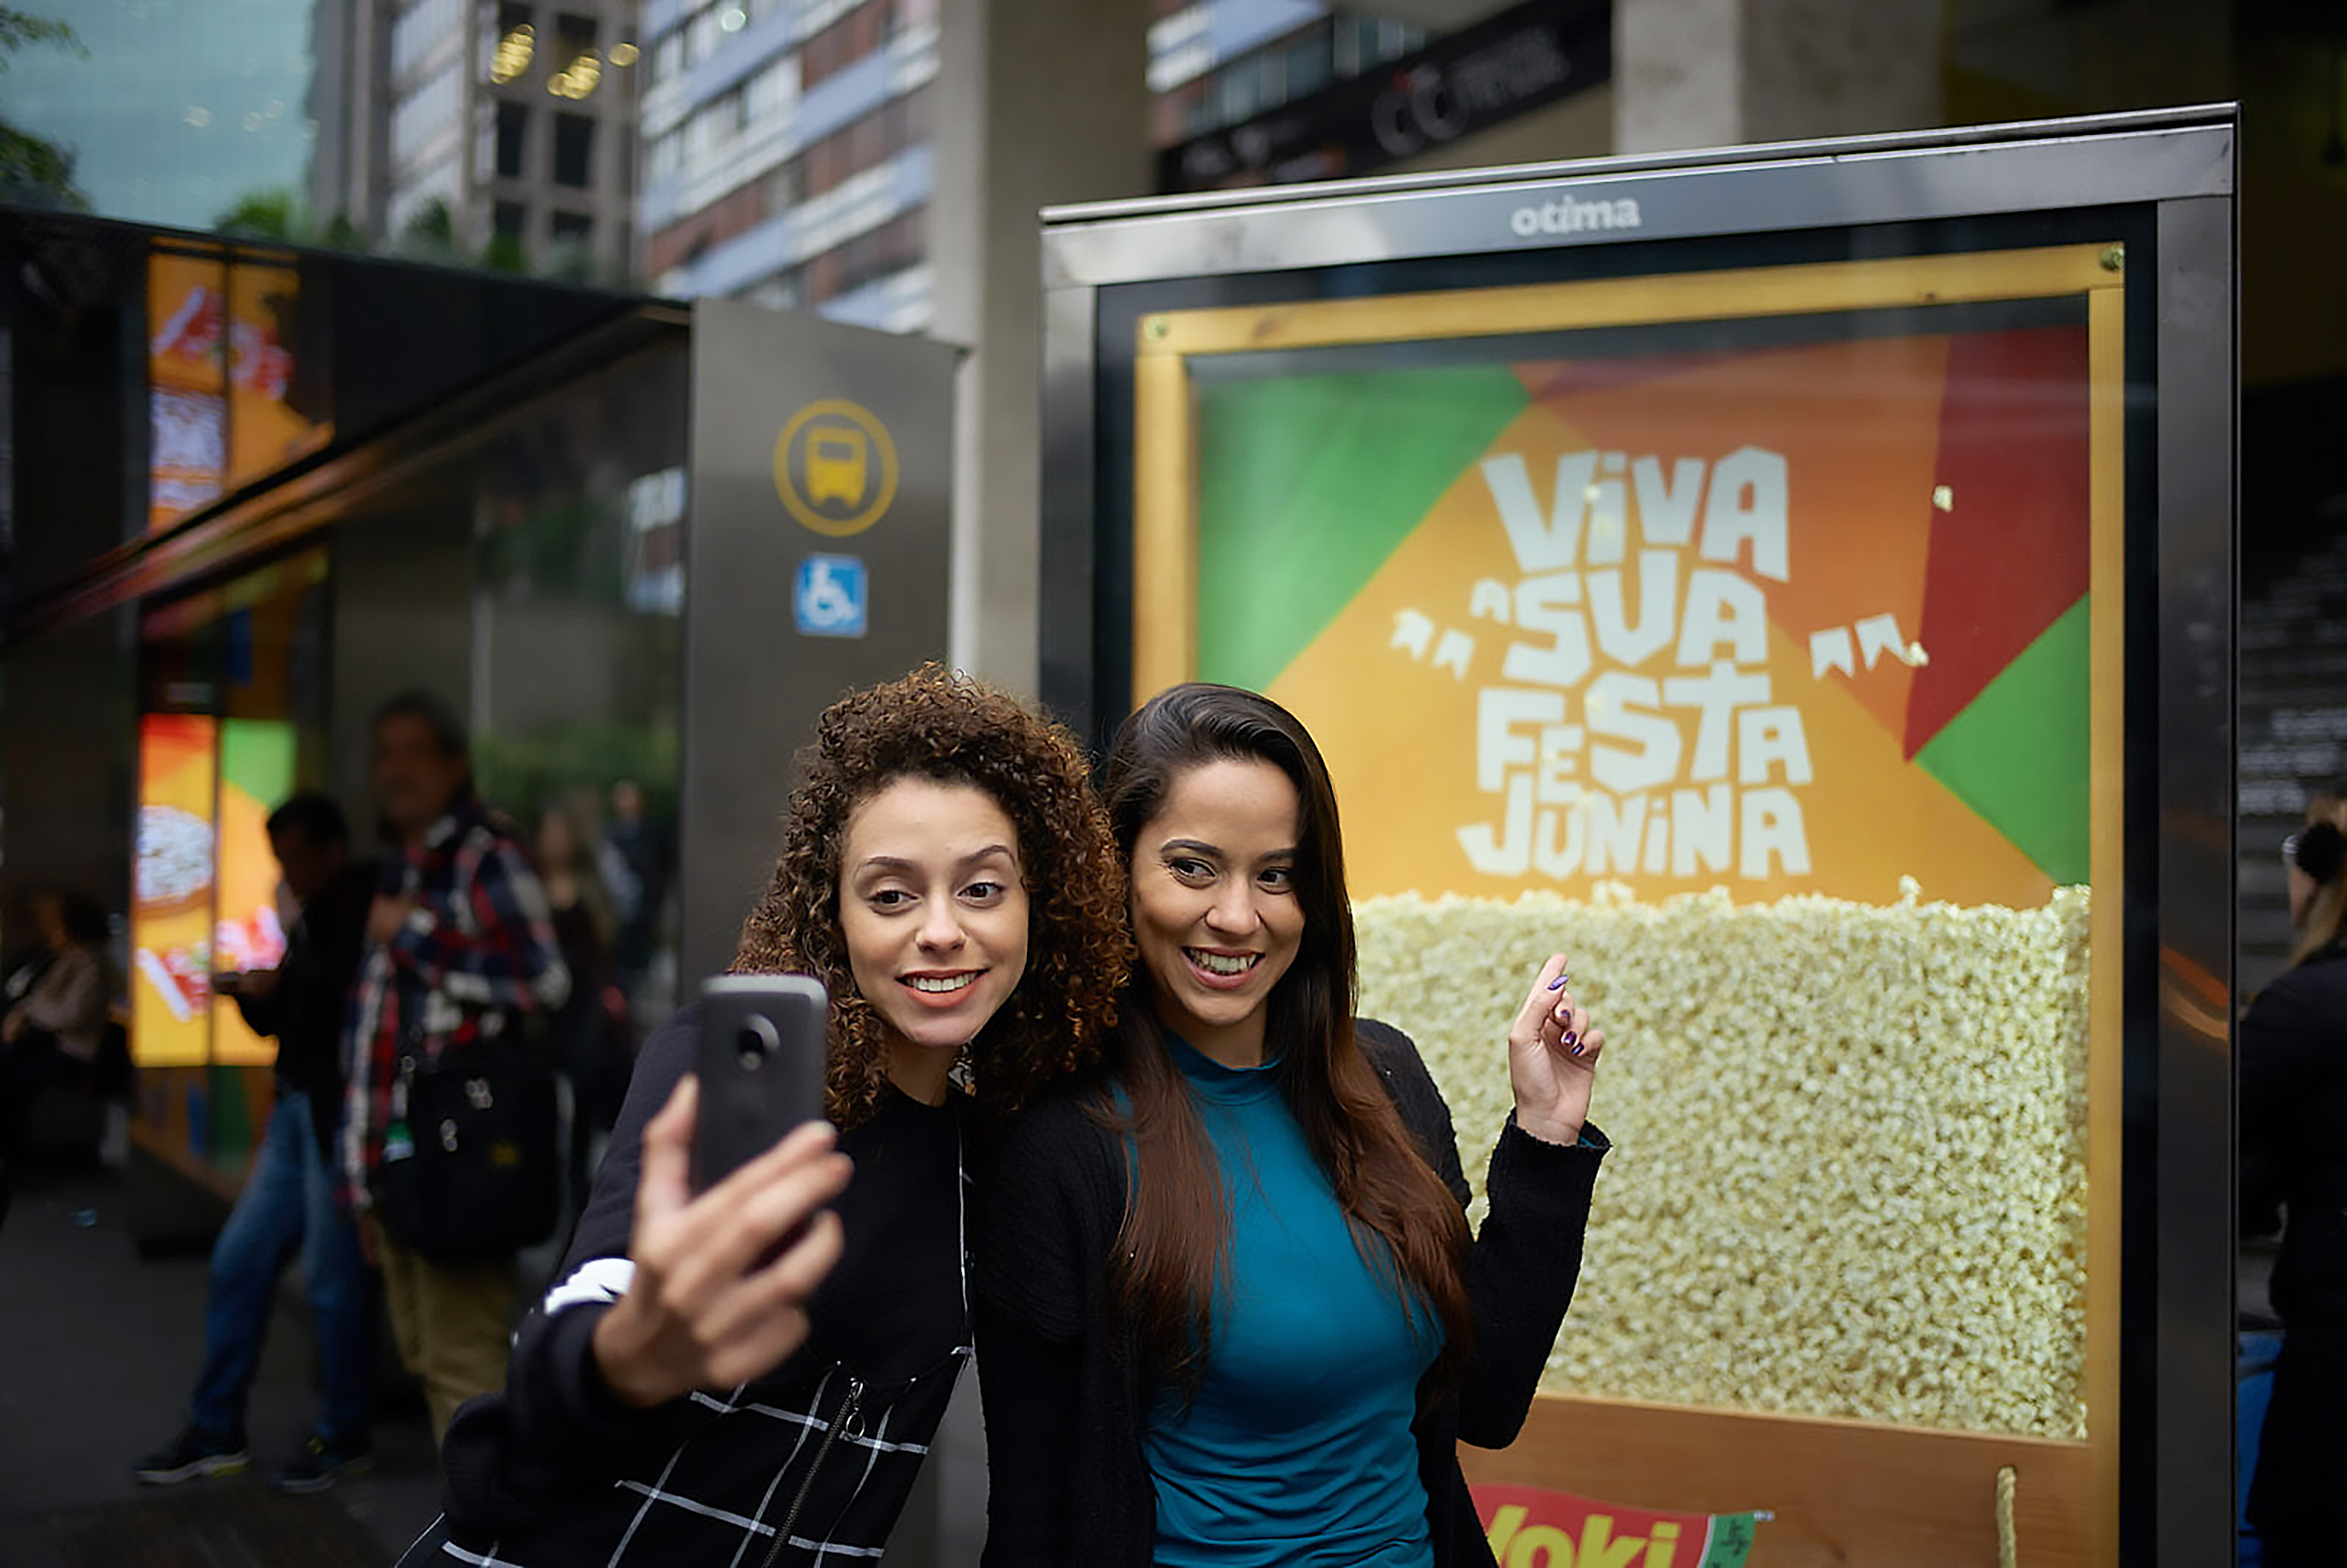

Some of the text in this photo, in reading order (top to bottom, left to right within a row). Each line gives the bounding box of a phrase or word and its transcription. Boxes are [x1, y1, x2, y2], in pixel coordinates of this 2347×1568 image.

[1511, 194, 1642, 235] otima
[1469, 549, 1768, 687] A SUA
[1476, 659, 1813, 805] FESTA
